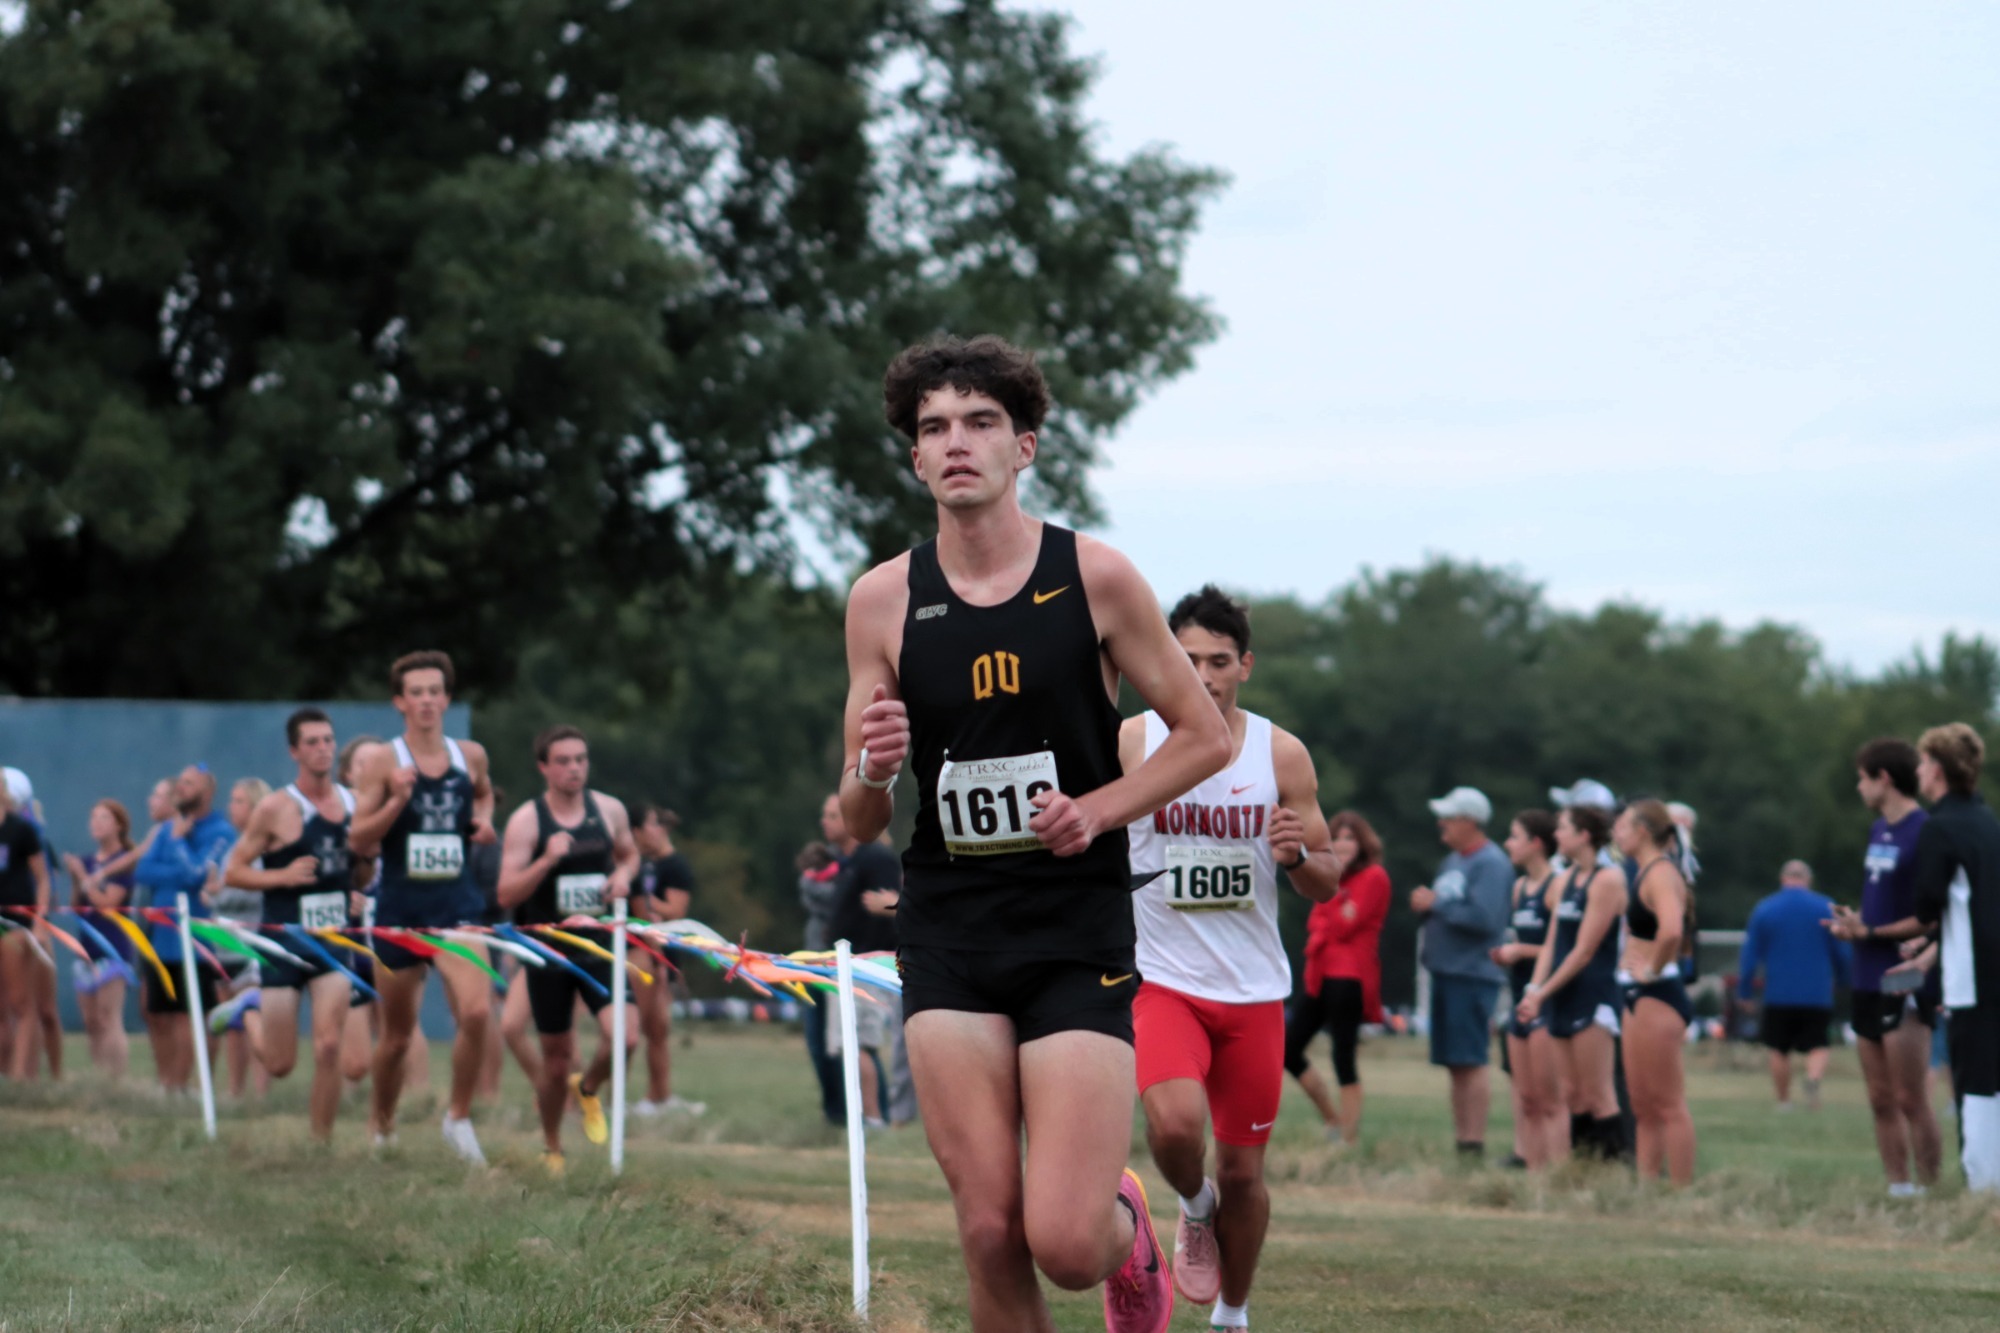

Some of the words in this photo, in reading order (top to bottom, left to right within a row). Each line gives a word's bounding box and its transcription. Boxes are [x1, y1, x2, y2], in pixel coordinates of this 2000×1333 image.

[972, 651, 1020, 701] QU
[963, 761, 1016, 775] TRXC
[1154, 801, 1265, 839] MONMOUTH
[1169, 864, 1251, 899] 1605
